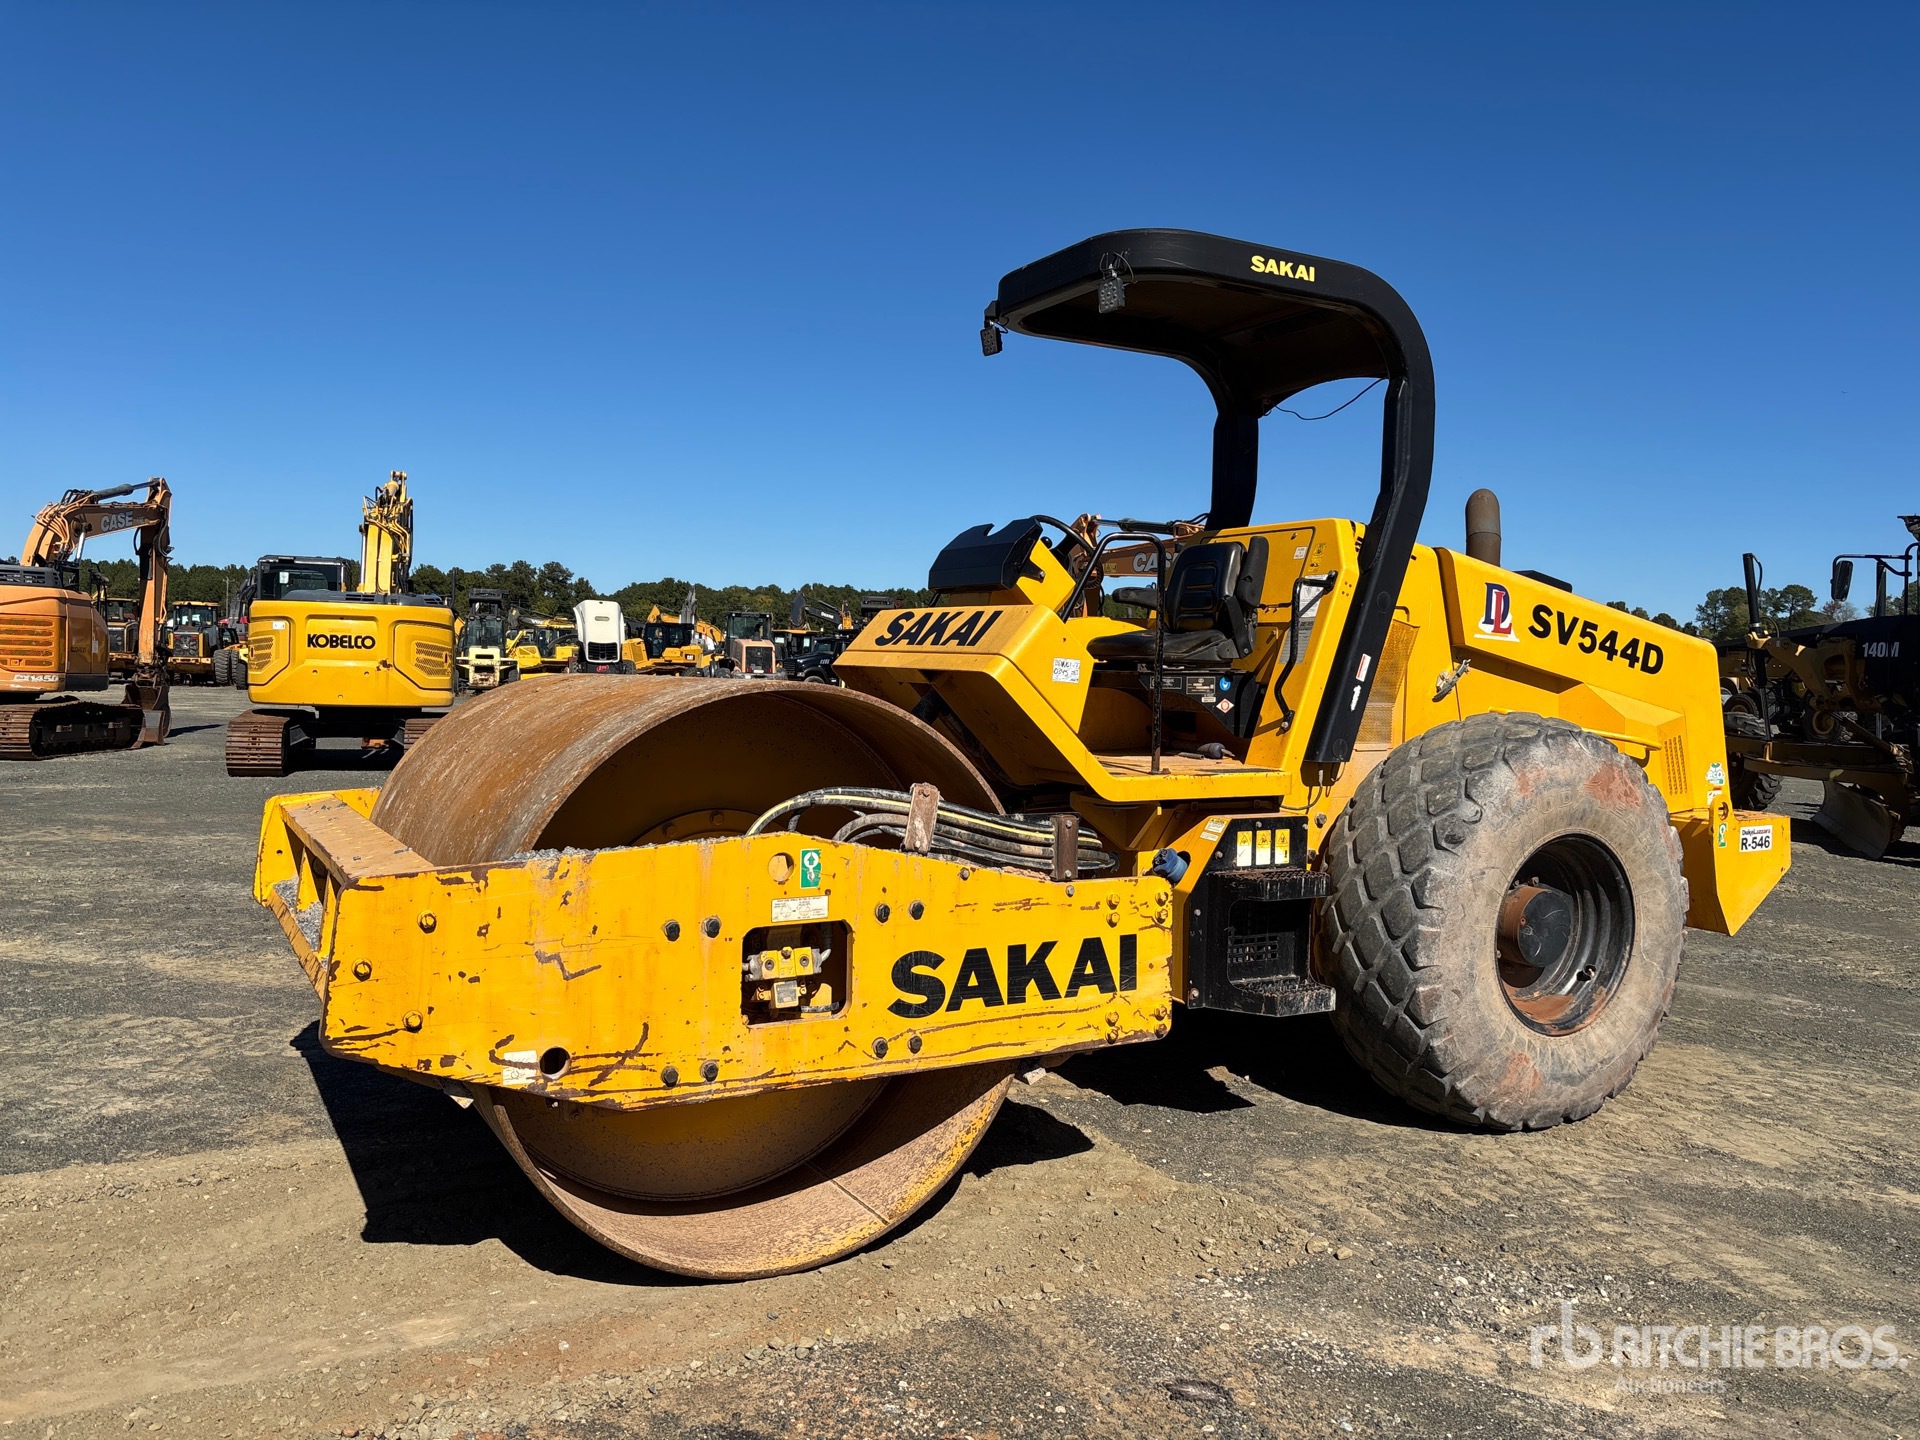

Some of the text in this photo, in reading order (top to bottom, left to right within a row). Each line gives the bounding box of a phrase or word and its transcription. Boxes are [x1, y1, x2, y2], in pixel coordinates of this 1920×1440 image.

[1250, 255, 1315, 282] SAKAI
[101, 511, 133, 532] CASE
[1133, 552, 1179, 572] CAS
[875, 611, 1003, 646] SAKAI
[307, 634, 376, 650] KOBELCO
[1528, 604, 1664, 675] SV544D
[1862, 641, 1900, 658] 140M
[1741, 836, 1771, 851] R-546
[887, 934, 1137, 1019] SAKAI
